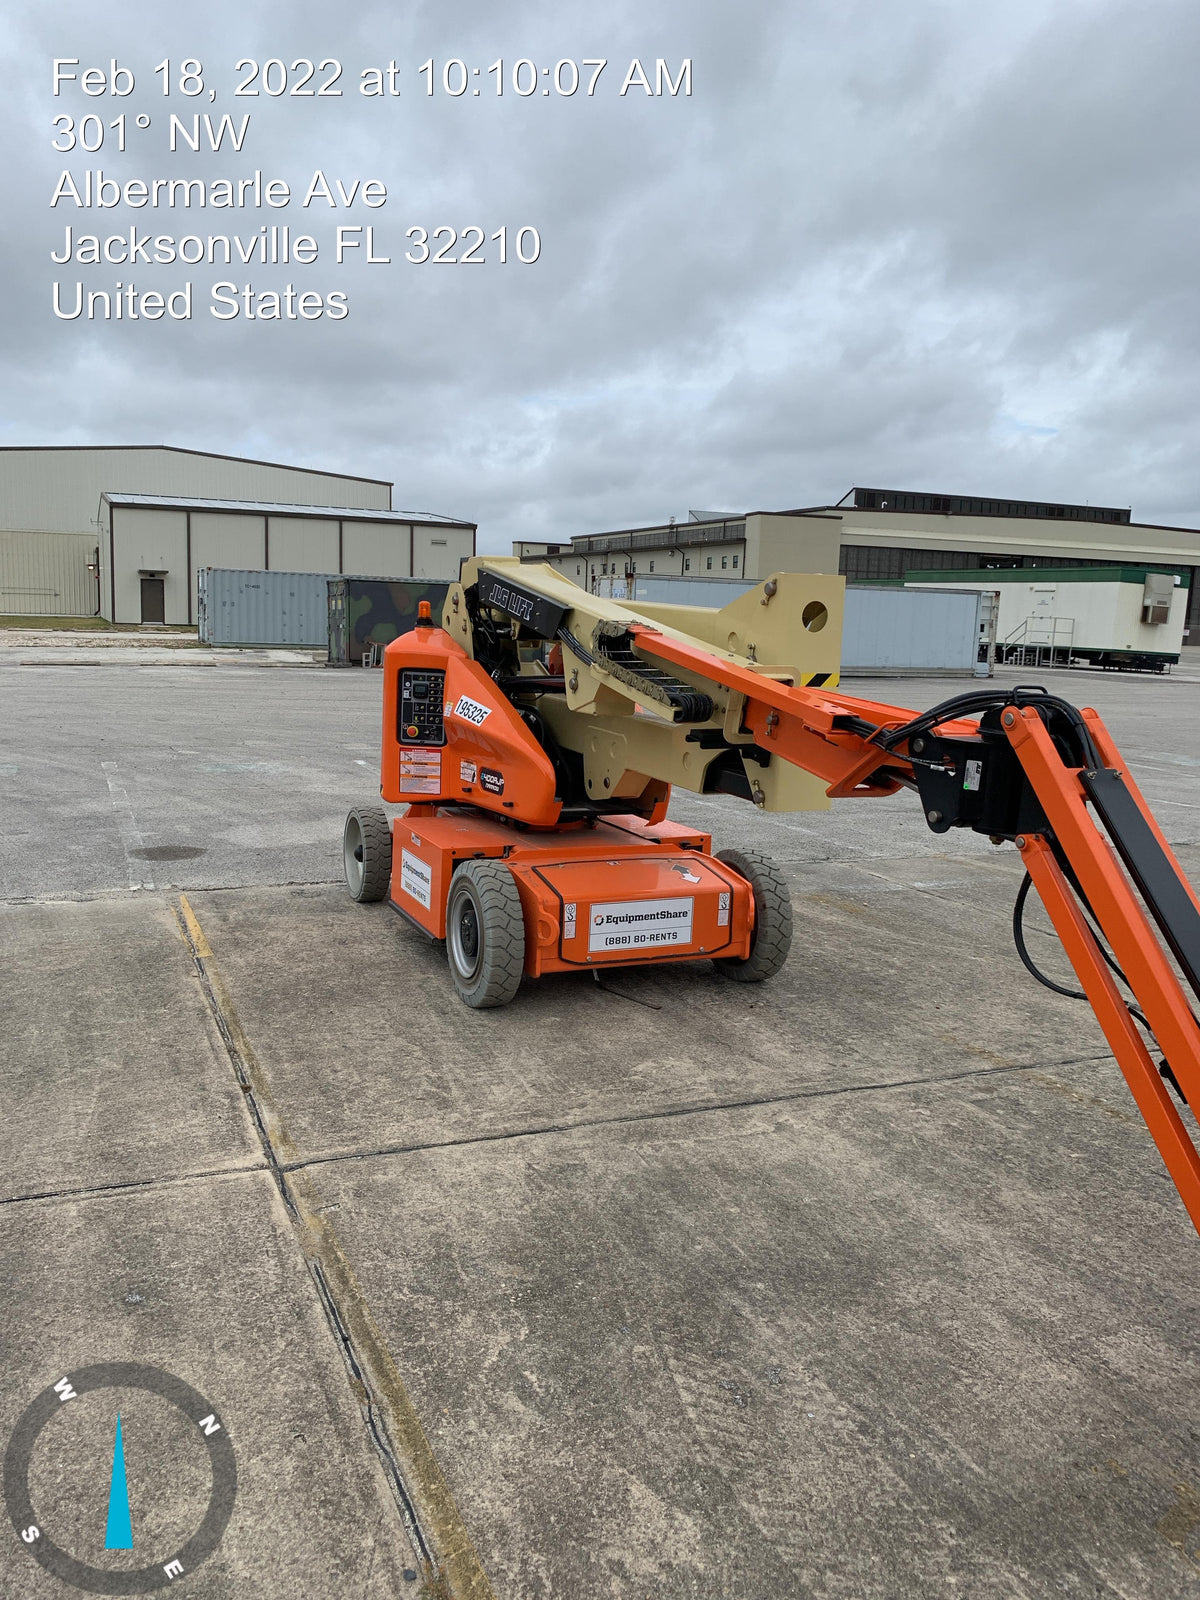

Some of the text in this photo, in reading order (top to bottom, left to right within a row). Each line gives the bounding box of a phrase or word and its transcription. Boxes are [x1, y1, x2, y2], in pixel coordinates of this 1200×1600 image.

[489, 583, 534, 621] JLG LIFT
[456, 699, 488, 724] 195325
[605, 910, 689, 925] EquipmentShare
[605, 932, 678, 946] (888) 80-RENTS
